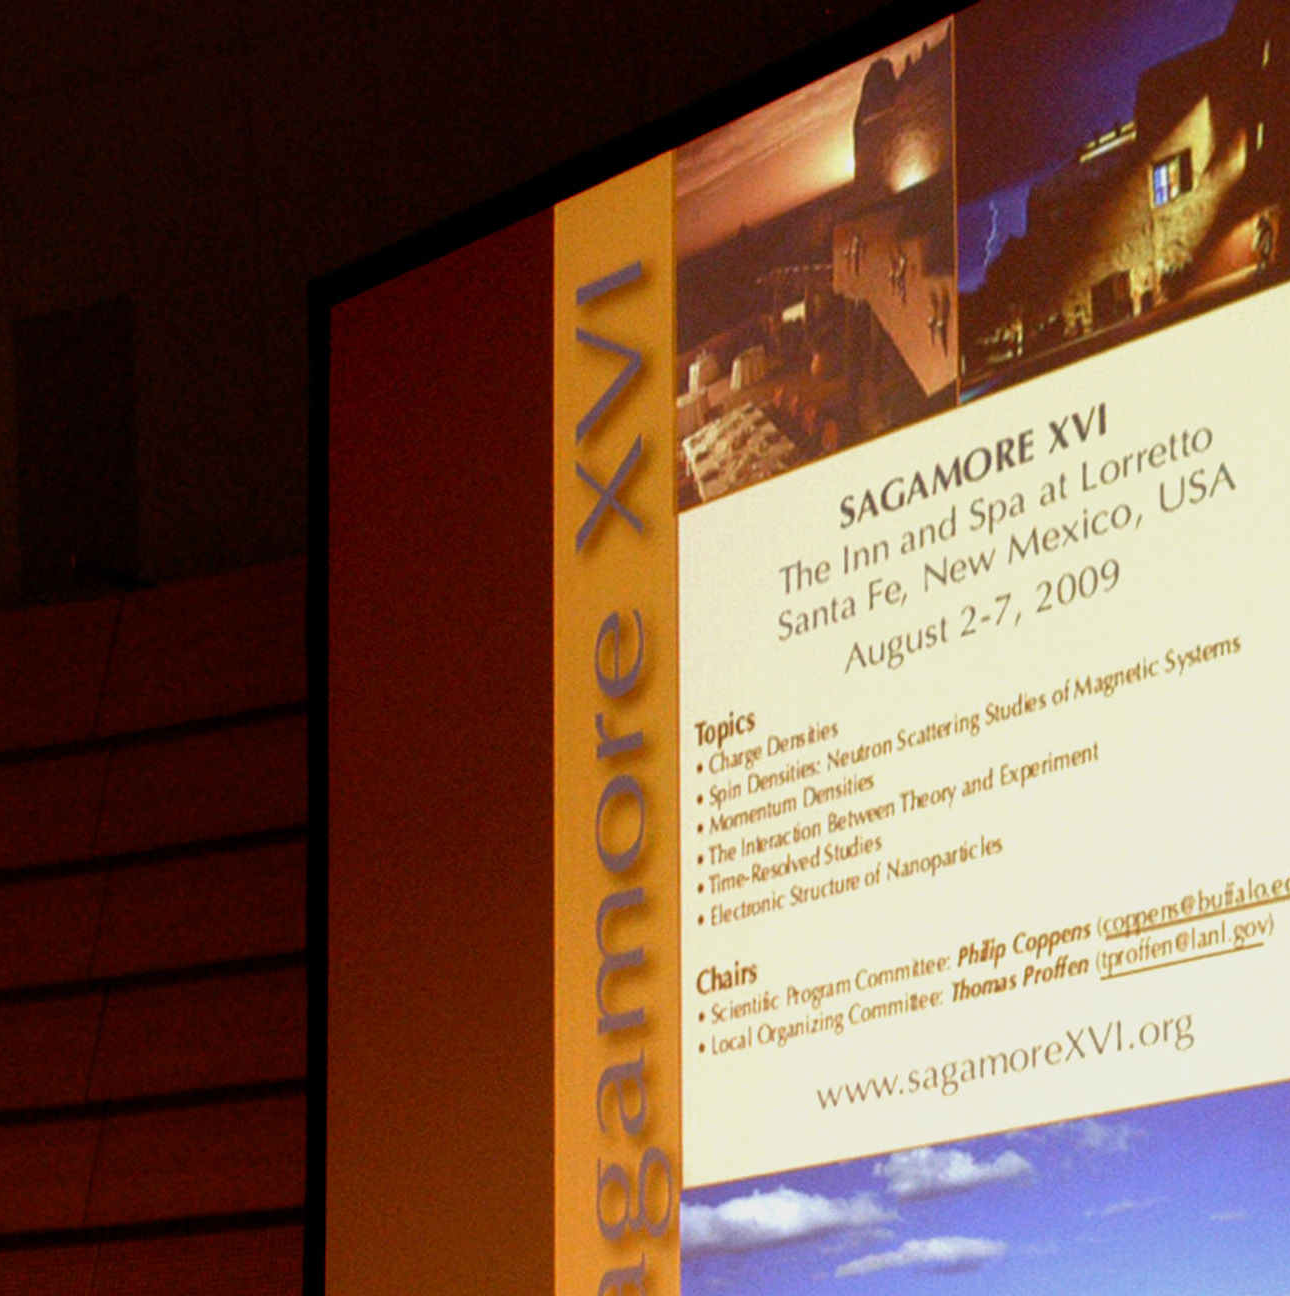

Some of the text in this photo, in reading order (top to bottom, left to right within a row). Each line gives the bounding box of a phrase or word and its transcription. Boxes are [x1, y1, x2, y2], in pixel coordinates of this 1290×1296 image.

[575, 260, 645, 554] XVI
[778, 427, 1214, 595] The Inn and Spa at Lorretto
[839, 401, 1107, 530] SAGAMORE XVI
[778, 461, 1237, 642] Santa Fe, New Mexico, USA
[844, 558, 1120, 674] August 2-7, 2009
[693, 710, 756, 750] Topics
[708, 722, 839, 775] Charge Densities
[709, 636, 1242, 811] Spin Densities: Neutron Scattering Studies of Magnetic Systems
[708, 741, 1099, 866] The Interaction Between Theory and Experiment
[708, 774, 875, 835] Momentum Densities
[708, 835, 883, 895] Time-Resolved Studies
[710, 834, 1004, 927] Electronic Structure of Nanoparticles
[695, 959, 758, 996] Chairs
[710, 990, 779, 1025] Scientific
[786, 978, 851, 1010] Program
[854, 956, 951, 991] Committee:
[1012, 922, 1092, 960] Coppens
[711, 1026, 753, 1056] Local
[756, 1012, 845, 1047] Organizing
[847, 990, 943, 1025] Committee:
[951, 973, 1018, 1003] Thomas
[1022, 954, 1090, 988] Proffen
[816, 1014, 1195, 1110] www.sagamoreXVI.org
